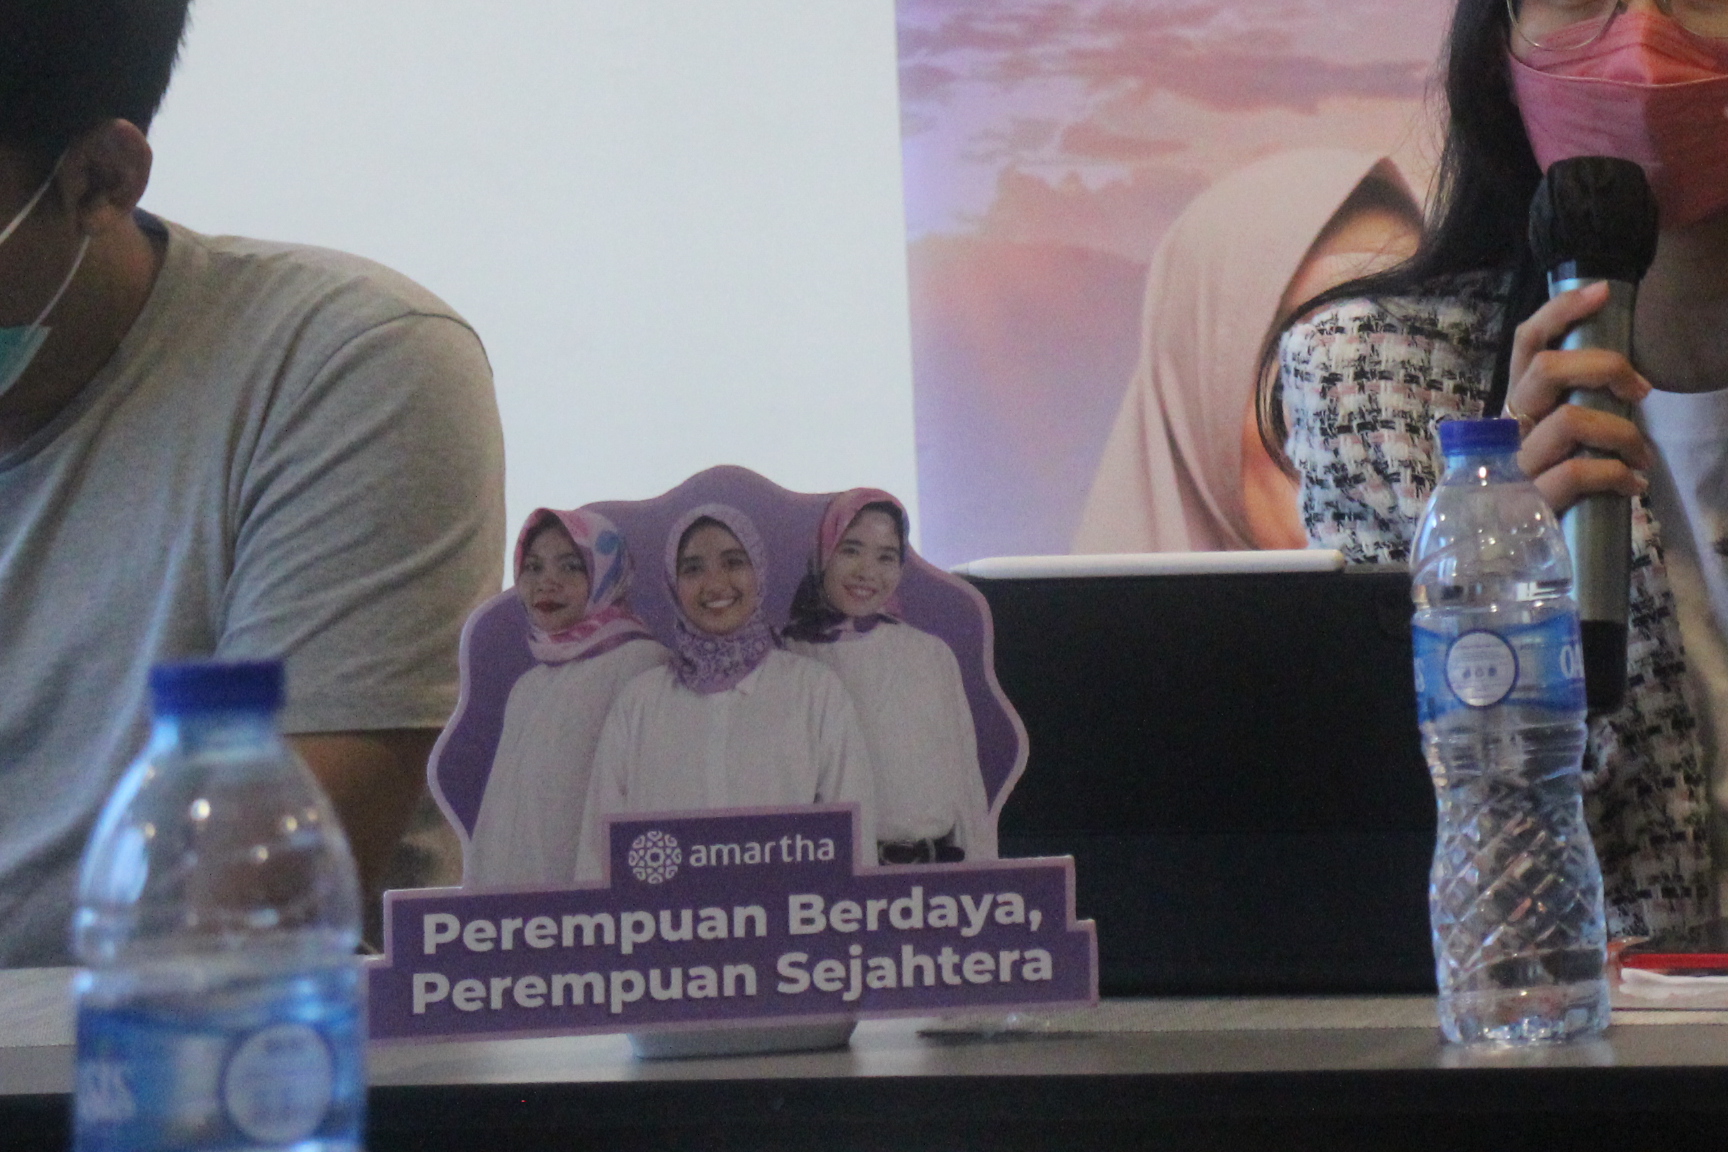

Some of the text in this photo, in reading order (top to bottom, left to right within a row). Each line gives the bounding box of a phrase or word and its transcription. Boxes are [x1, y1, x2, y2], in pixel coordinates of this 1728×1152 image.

[688, 833, 836, 868] amartha
[423, 885, 1043, 955] Perempuan Berdaya,
[412, 943, 1053, 1014] Perempuan Sejahtera
